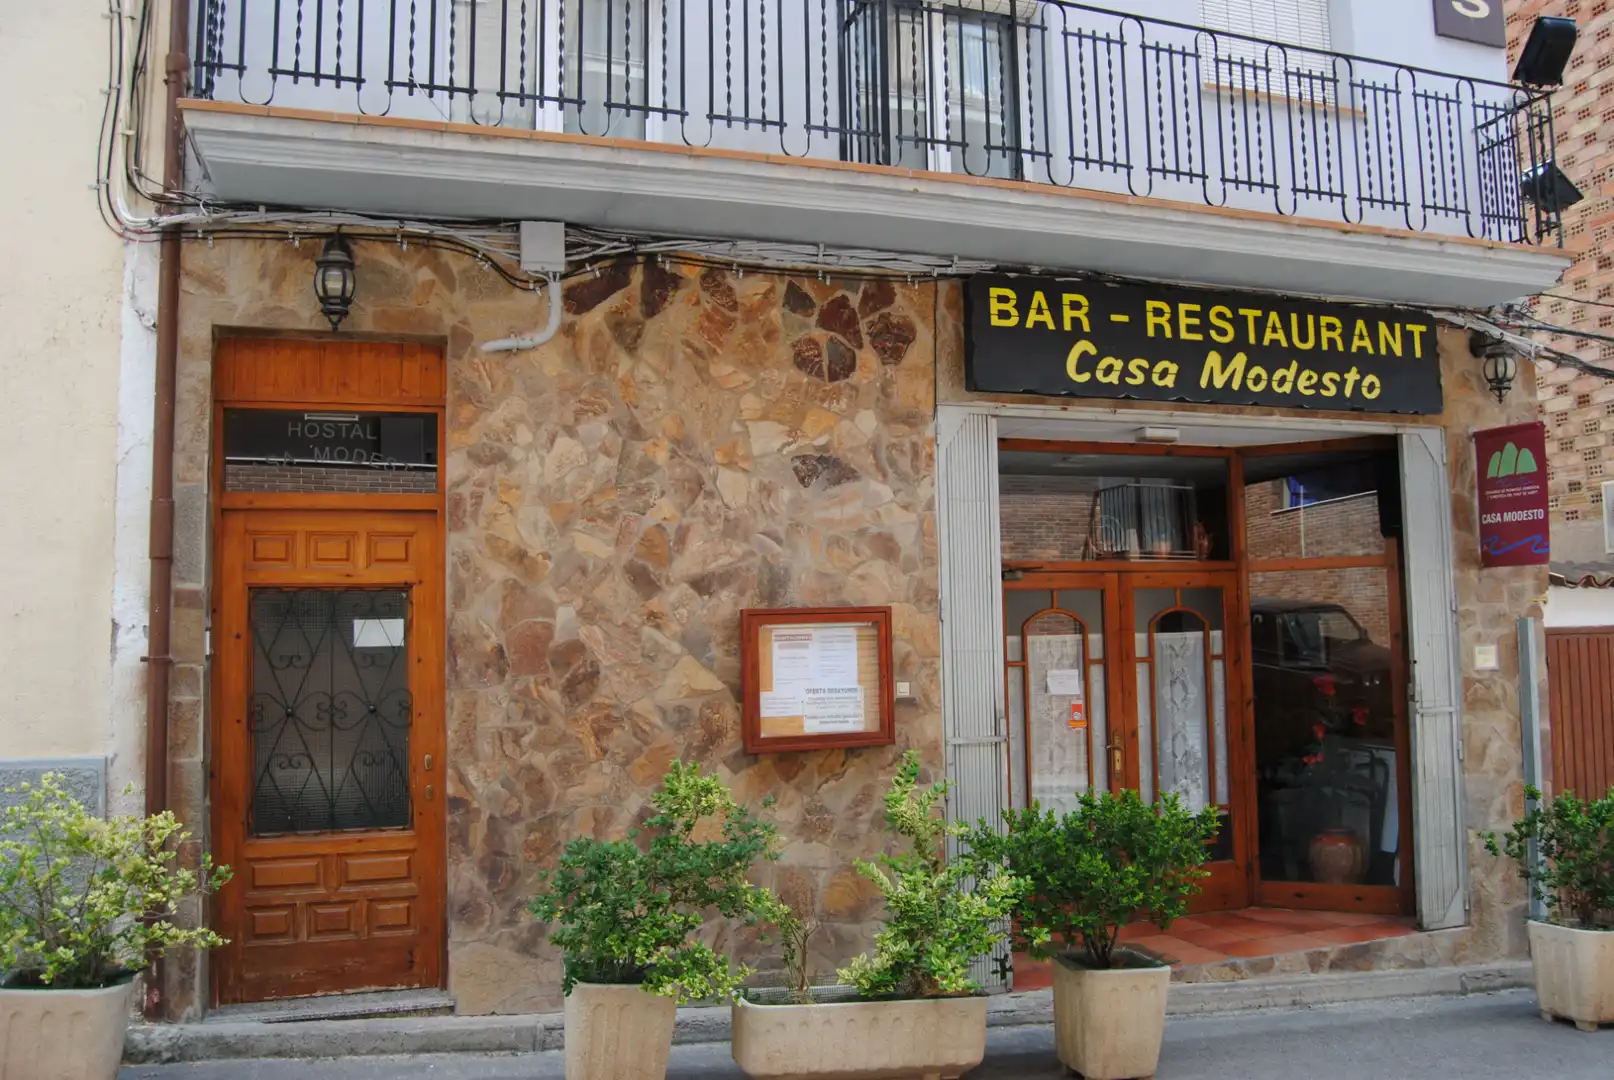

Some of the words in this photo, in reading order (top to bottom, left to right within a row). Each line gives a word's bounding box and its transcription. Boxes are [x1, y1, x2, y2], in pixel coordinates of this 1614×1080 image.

[989, 287, 1091, 332] BAR
[1146, 300, 1427, 358] RESTAURANT
[1066, 339, 1179, 389] Casa
[1200, 350, 1381, 399] Modesto
[287, 421, 377, 440] HOSTAL
[1482, 512, 1501, 525] CASA
[1503, 508, 1544, 522] MODESTO
